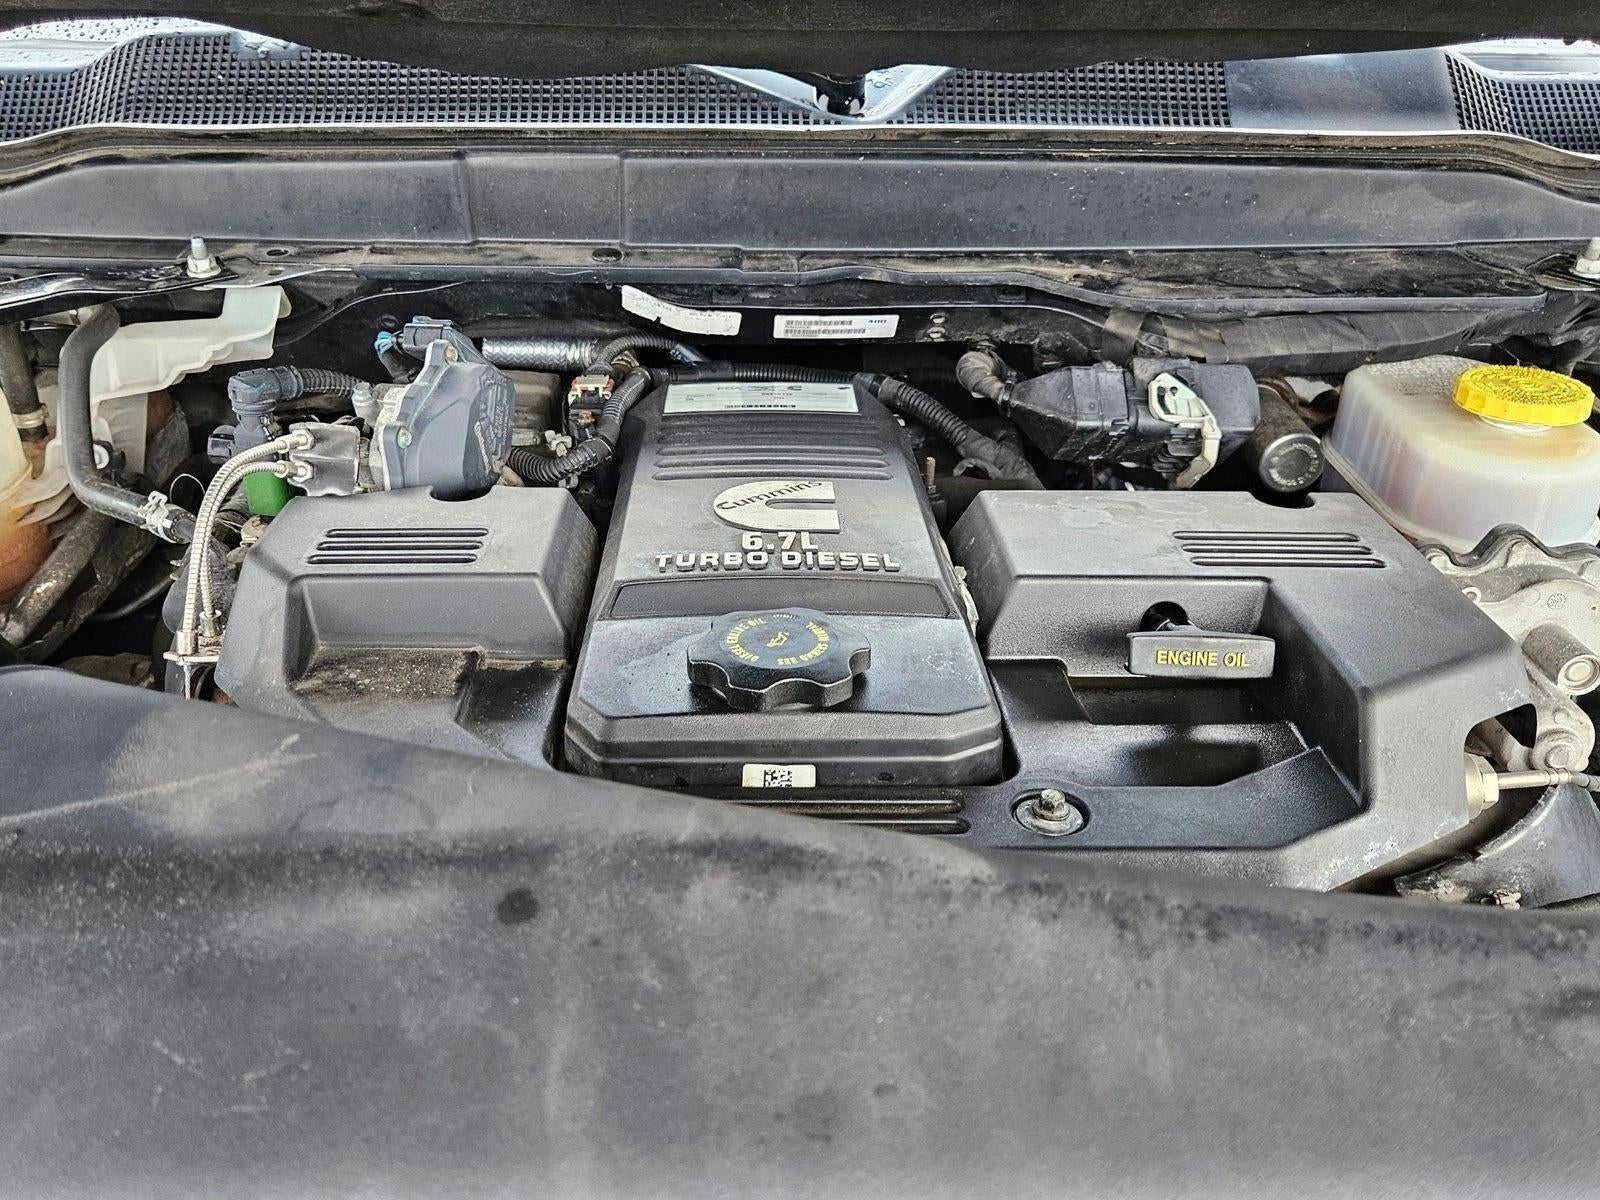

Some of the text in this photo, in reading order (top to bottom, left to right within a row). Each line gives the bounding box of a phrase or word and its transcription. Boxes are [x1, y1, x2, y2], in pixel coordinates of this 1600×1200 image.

[715, 479, 823, 510] Cummins
[741, 531, 819, 553] 6.7L
[655, 551, 900, 572] TURBO DIESEL
[726, 617, 768, 662] DIESEL ENGINE OIL
[777, 657, 799, 666] SEE
[1156, 650, 1250, 668] ENGINE OIL
